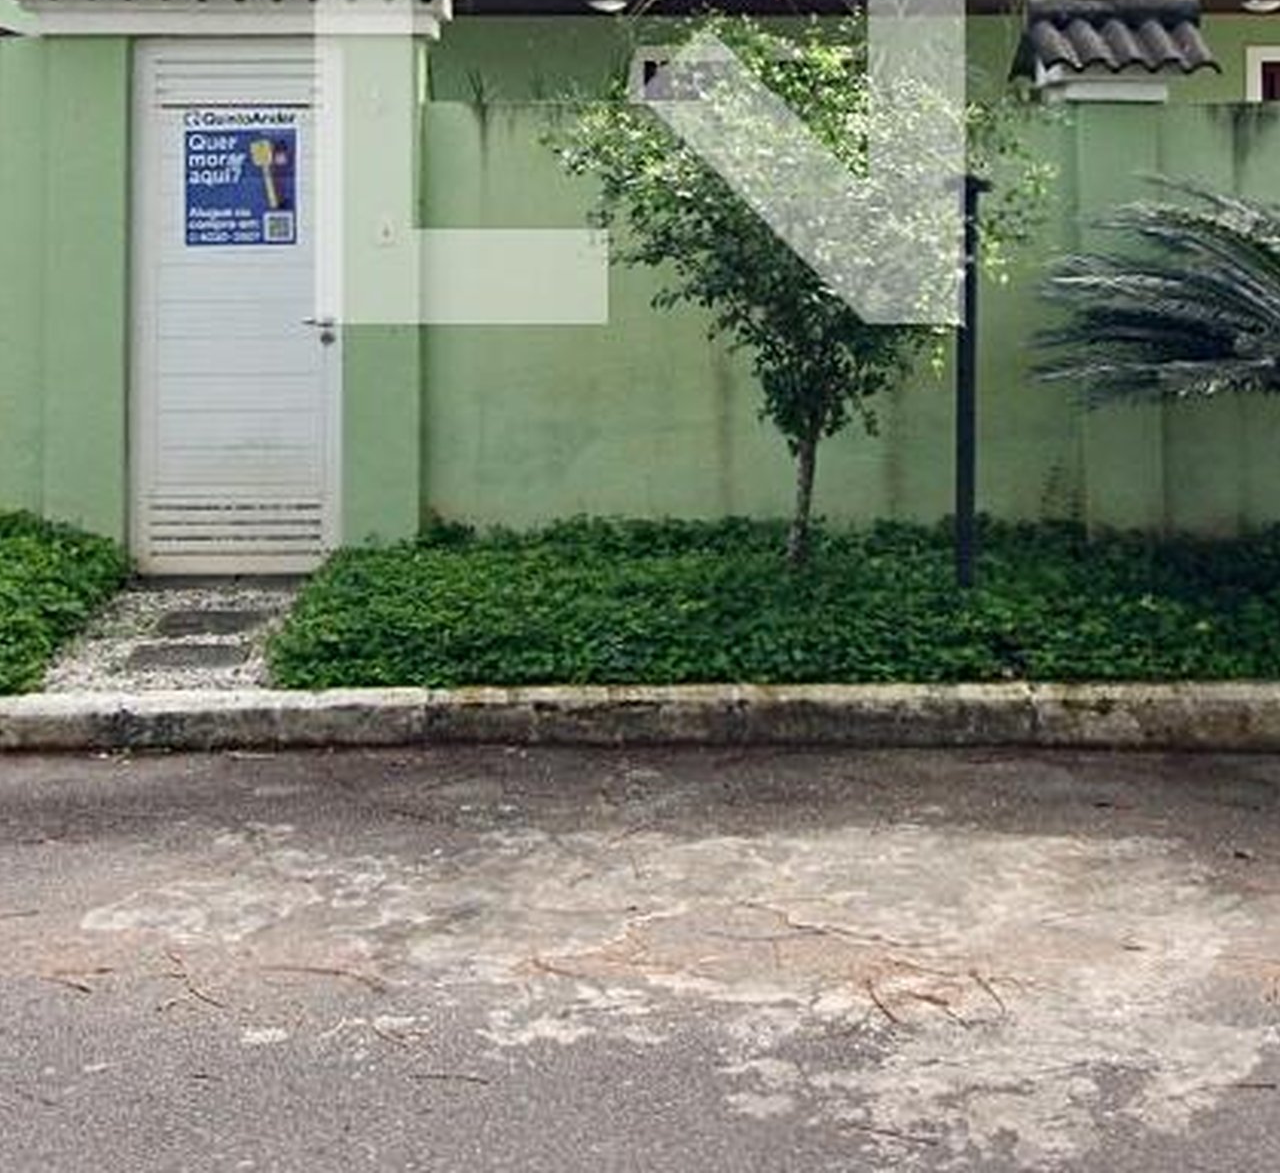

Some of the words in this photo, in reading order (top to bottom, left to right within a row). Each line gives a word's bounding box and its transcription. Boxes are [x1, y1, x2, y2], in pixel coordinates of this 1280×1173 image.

[188, 134, 237, 150] Quer
[188, 153, 246, 167] morar
[188, 168, 241, 186] aqui?
